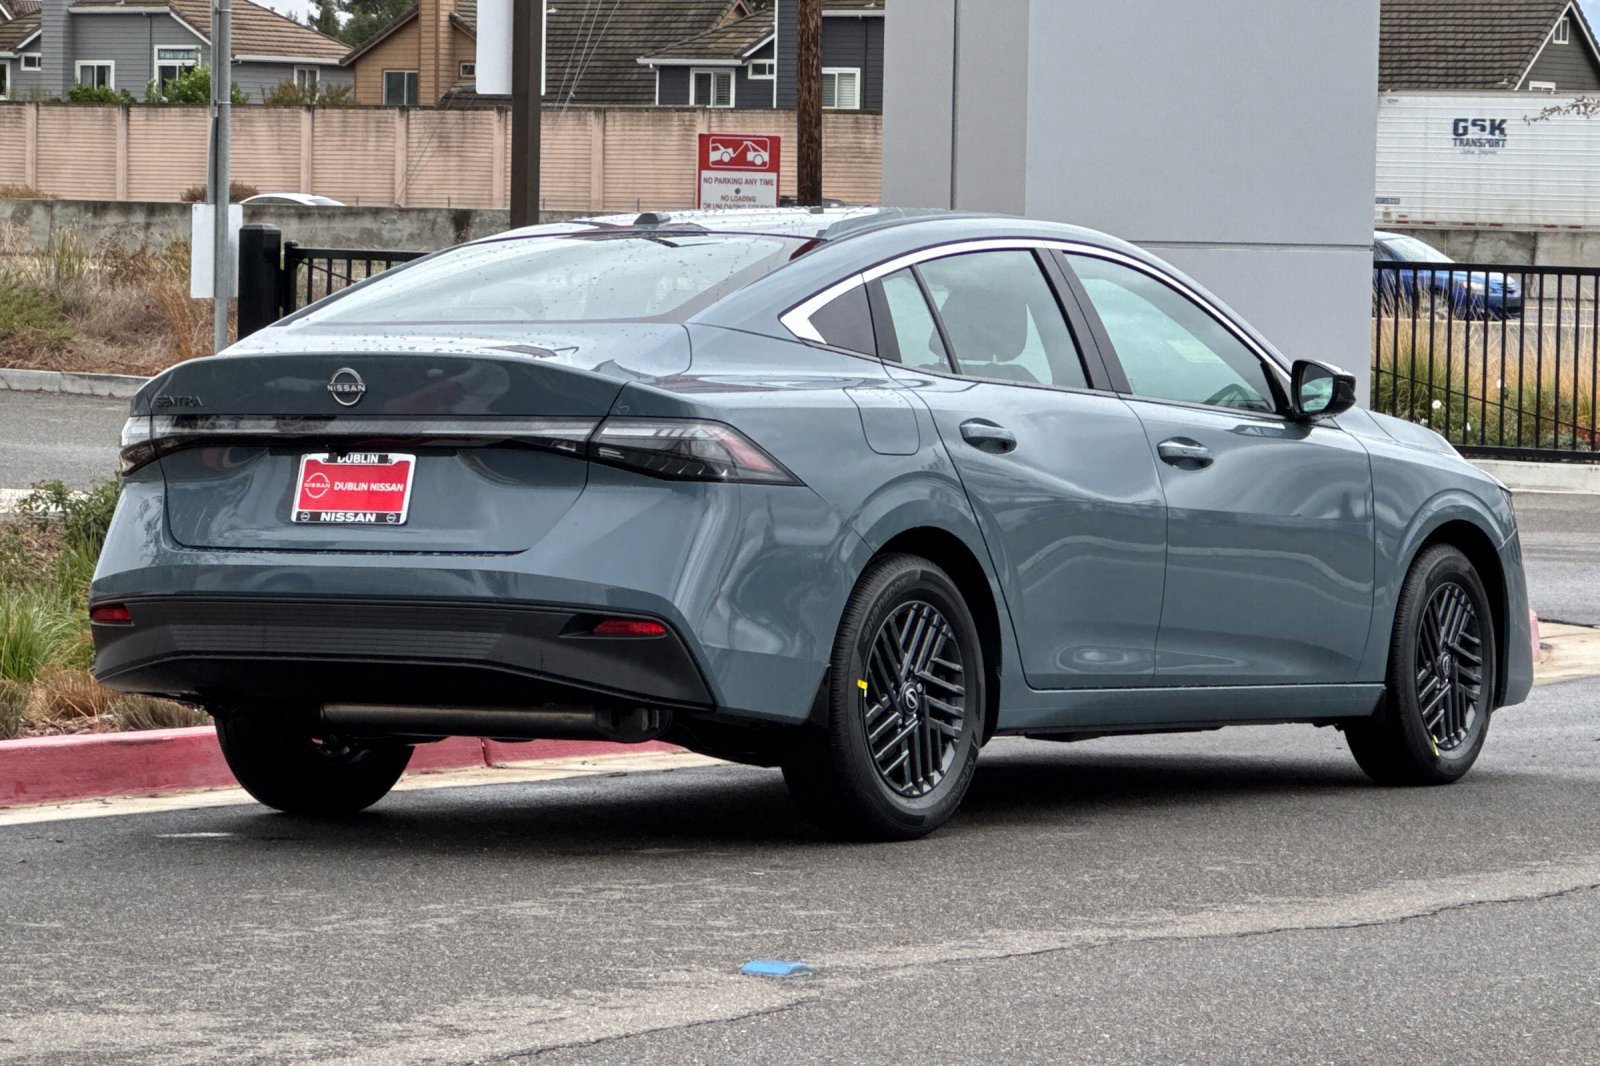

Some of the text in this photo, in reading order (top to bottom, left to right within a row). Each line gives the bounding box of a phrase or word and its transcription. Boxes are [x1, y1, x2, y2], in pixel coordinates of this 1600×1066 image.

[1453, 118, 1507, 137] GSK
[1452, 138, 1507, 148] TRANSPORT
[714, 177, 743, 185] PARKING
[156, 395, 203, 407] SENTRA
[333, 481, 404, 492] DUBLIN NISSAN
[320, 512, 376, 522] NISSAN
